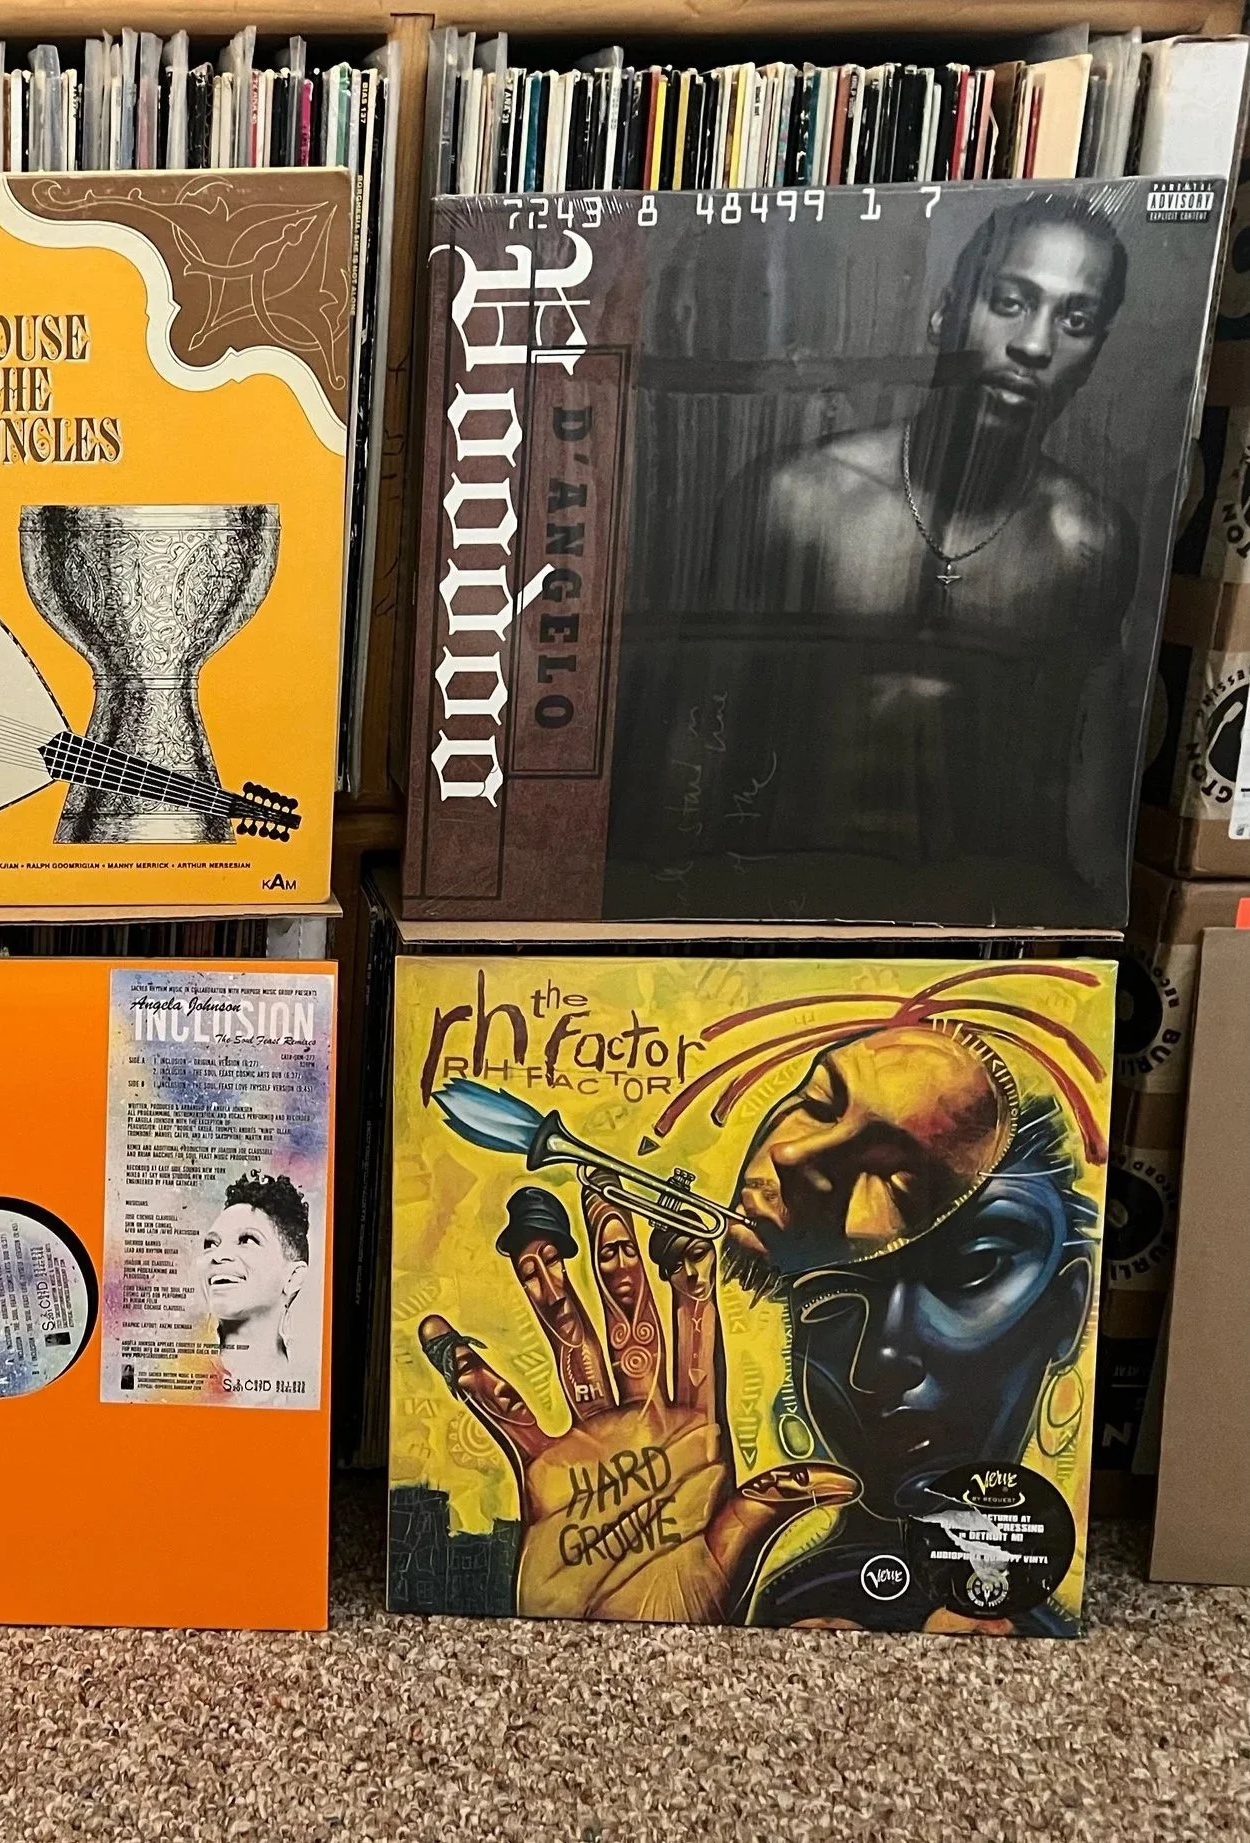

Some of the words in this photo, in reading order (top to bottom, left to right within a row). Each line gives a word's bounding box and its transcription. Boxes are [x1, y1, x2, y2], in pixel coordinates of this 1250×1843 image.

[1153, 182, 1212, 192] PARENTAL
[503, 196, 602, 230] 7243
[638, 194, 658, 227] 8
[696, 190, 826, 225] 48499
[860, 188, 882, 220] 1
[918, 186, 942, 219] 7
[1150, 194, 1211, 209] ADVISORY
[1150, 212, 1178, 220] EXPLICIT
[1180, 212, 1208, 220] CONTENT
[534, 405, 594, 731] D'ANGELO
[262, 873, 297, 890] KAM
[130, 995, 182, 1015] Angela
[186, 996, 242, 1016] Johnson
[530, 978, 590, 1018] the
[134, 998, 315, 1043] INCLUSION
[215, 1034, 231, 1044] The
[256, 1036, 280, 1046] Feast
[283, 1037, 316, 1046] Remixes
[420, 968, 528, 1109] rh
[544, 1008, 706, 1088] Factor
[194, 1058, 217, 1066] ORIGINAL
[160, 1068, 187, 1076] INCLUSION
[204, 1069, 216, 1077] SOUL
[236, 1070, 255, 1078] COSMIC
[257, 1071, 270, 1079] ARTS
[272, 1071, 282, 1079] DUB
[442, 1056, 510, 1081] RH
[526, 1065, 672, 1104] FACTOR
[128, 1080, 139, 1088] SIDE
[204, 1082, 216, 1090] SOUL
[218, 1083, 233, 1091] FEAST
[250, 1084, 271, 1092] THYSELF
[273, 1084, 294, 1092] VERSION
[566, 1445, 672, 1521] HARD
[970, 1470, 1018, 1496] Verve
[997, 1522, 1044, 1533] PRESSING
[1020, 1515, 1031, 1523] AT
[558, 1495, 682, 1567] GROOVE
[969, 1532, 1008, 1542] DETROIT
[1023, 1555, 1048, 1564] VINYL
[866, 1568, 903, 1590] Verve
